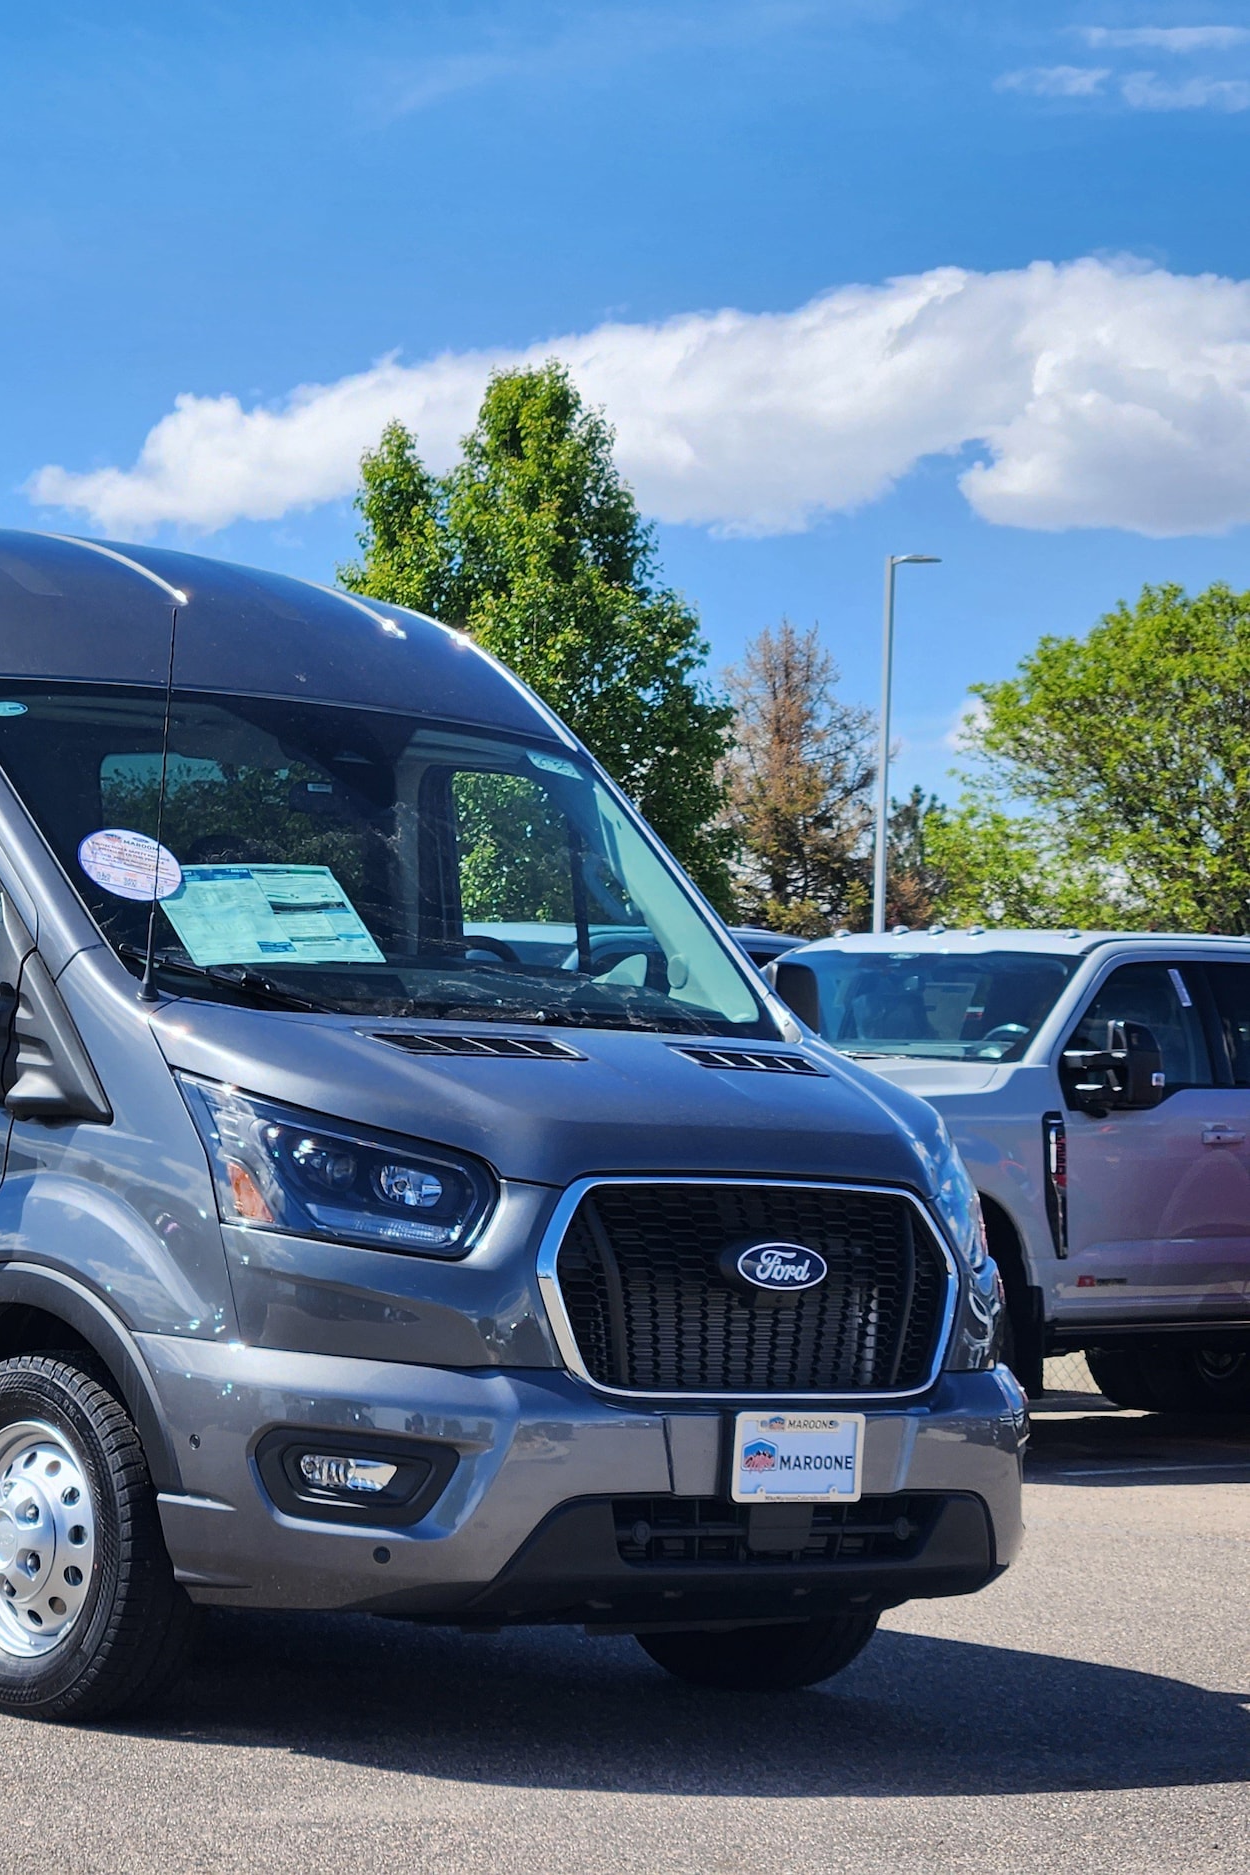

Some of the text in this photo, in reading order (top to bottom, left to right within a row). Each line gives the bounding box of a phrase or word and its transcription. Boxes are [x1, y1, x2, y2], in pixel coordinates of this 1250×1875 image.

[123, 839, 162, 851] MAROON
[755, 1249, 811, 1282] Ford
[779, 1455, 853, 1470] MAROONE
